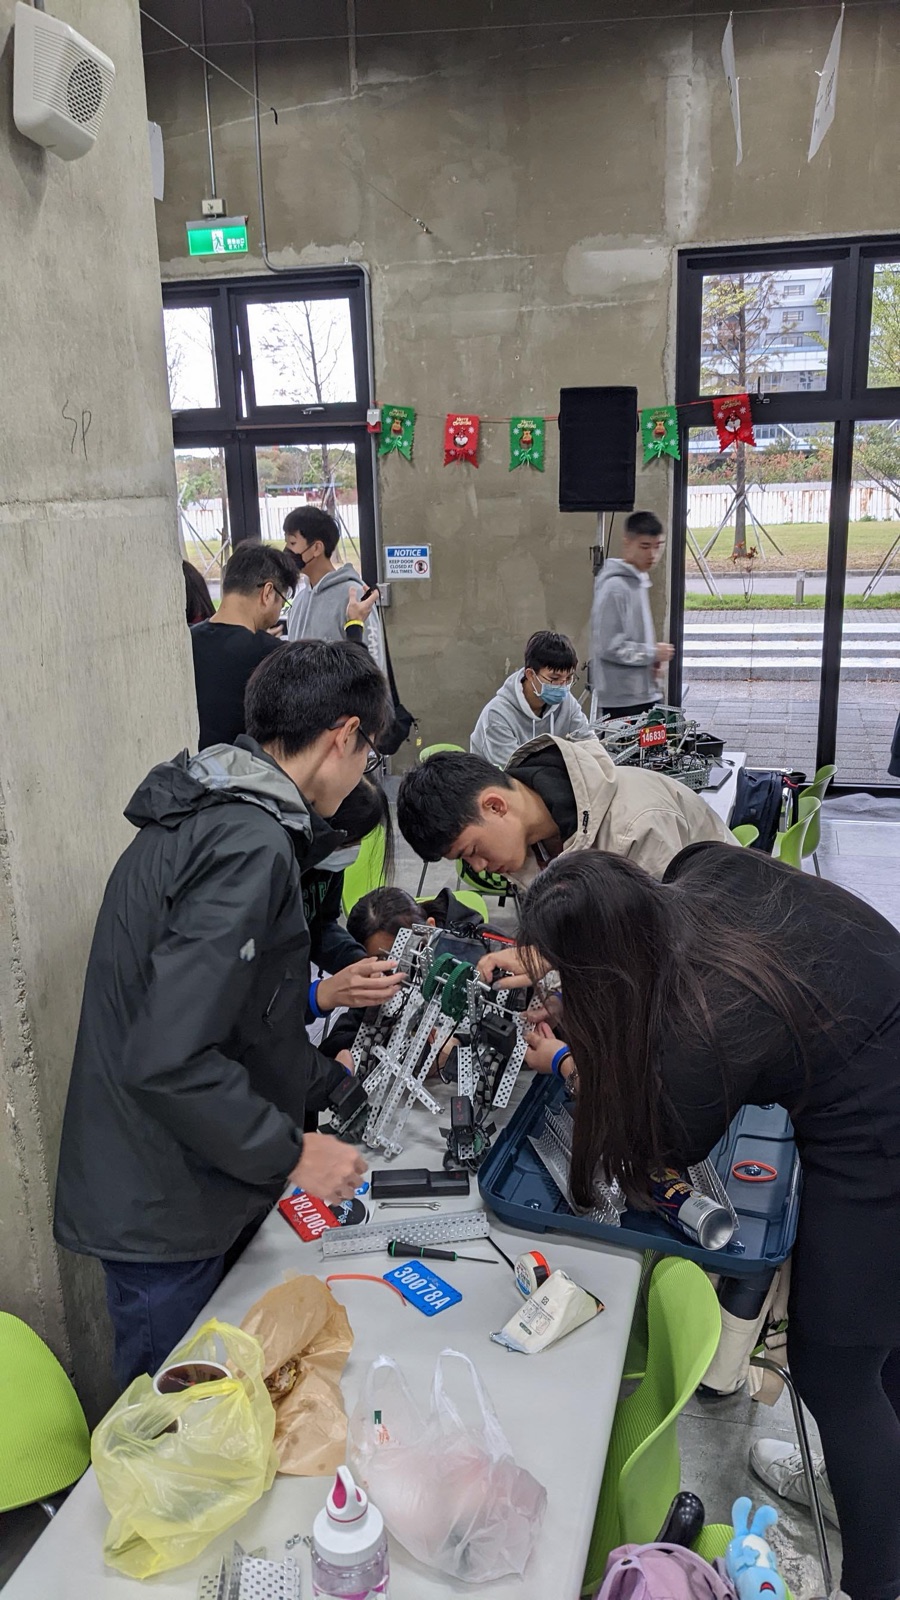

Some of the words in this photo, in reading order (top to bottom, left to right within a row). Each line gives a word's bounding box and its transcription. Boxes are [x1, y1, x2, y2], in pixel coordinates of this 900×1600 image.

[394, 549, 422, 557] NOTICE
[289, 1194, 331, 1236] 30078A
[393, 1266, 451, 1310] 30078A
